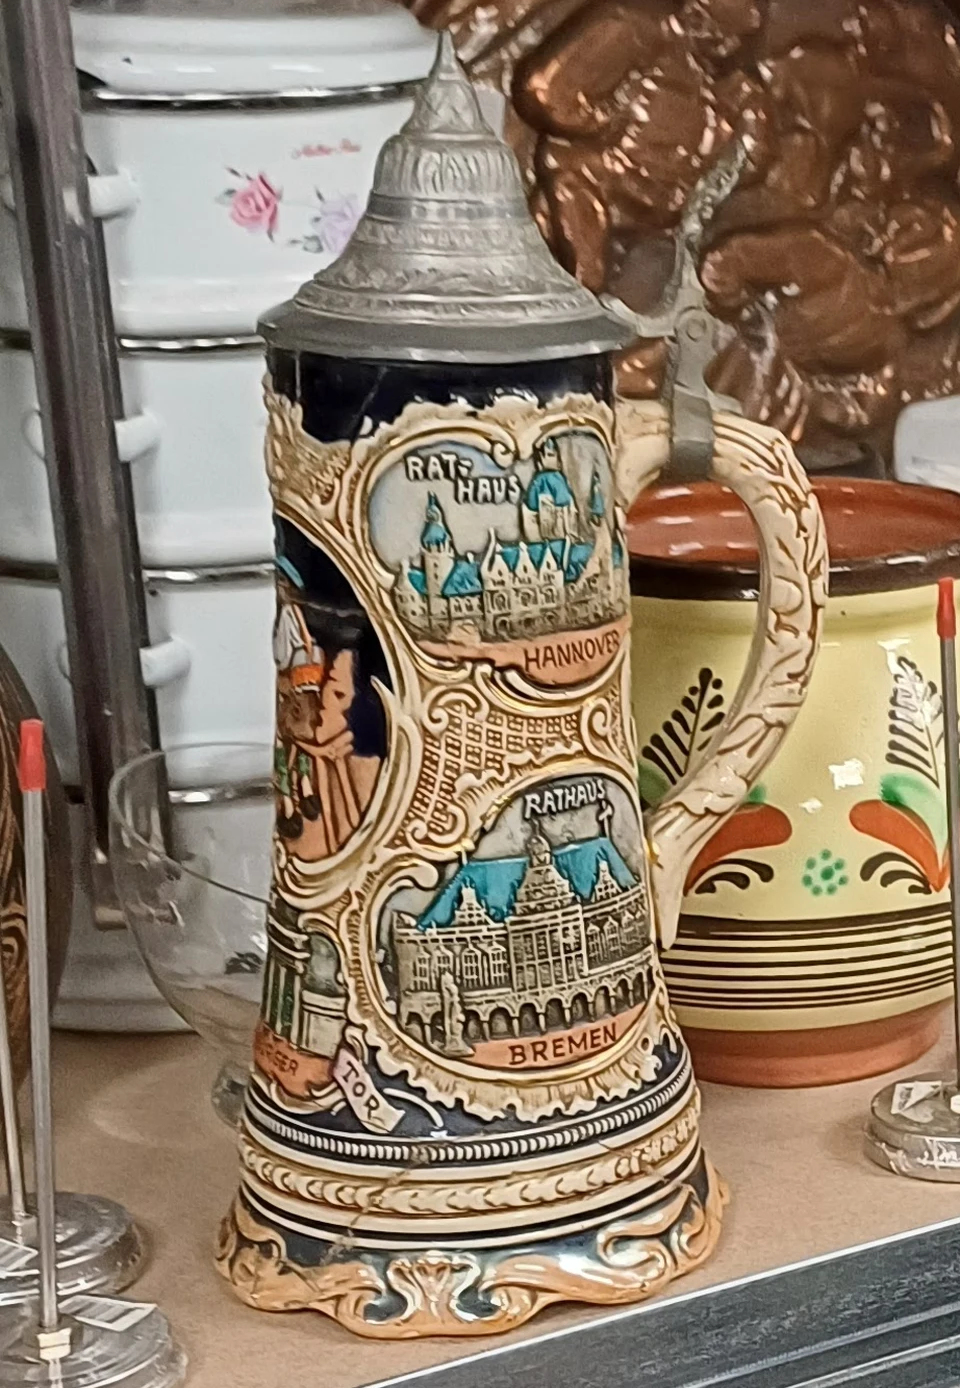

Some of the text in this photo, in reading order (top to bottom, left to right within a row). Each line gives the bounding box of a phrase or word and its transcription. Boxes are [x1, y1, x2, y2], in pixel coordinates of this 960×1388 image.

[457, 475, 521, 505] HAUS
[523, 629, 620, 672] HANNOVER
[524, 778, 605, 819] RATHAUS
[508, 1022, 618, 1066] BREMEN
[342, 1060, 381, 1120] TOR
